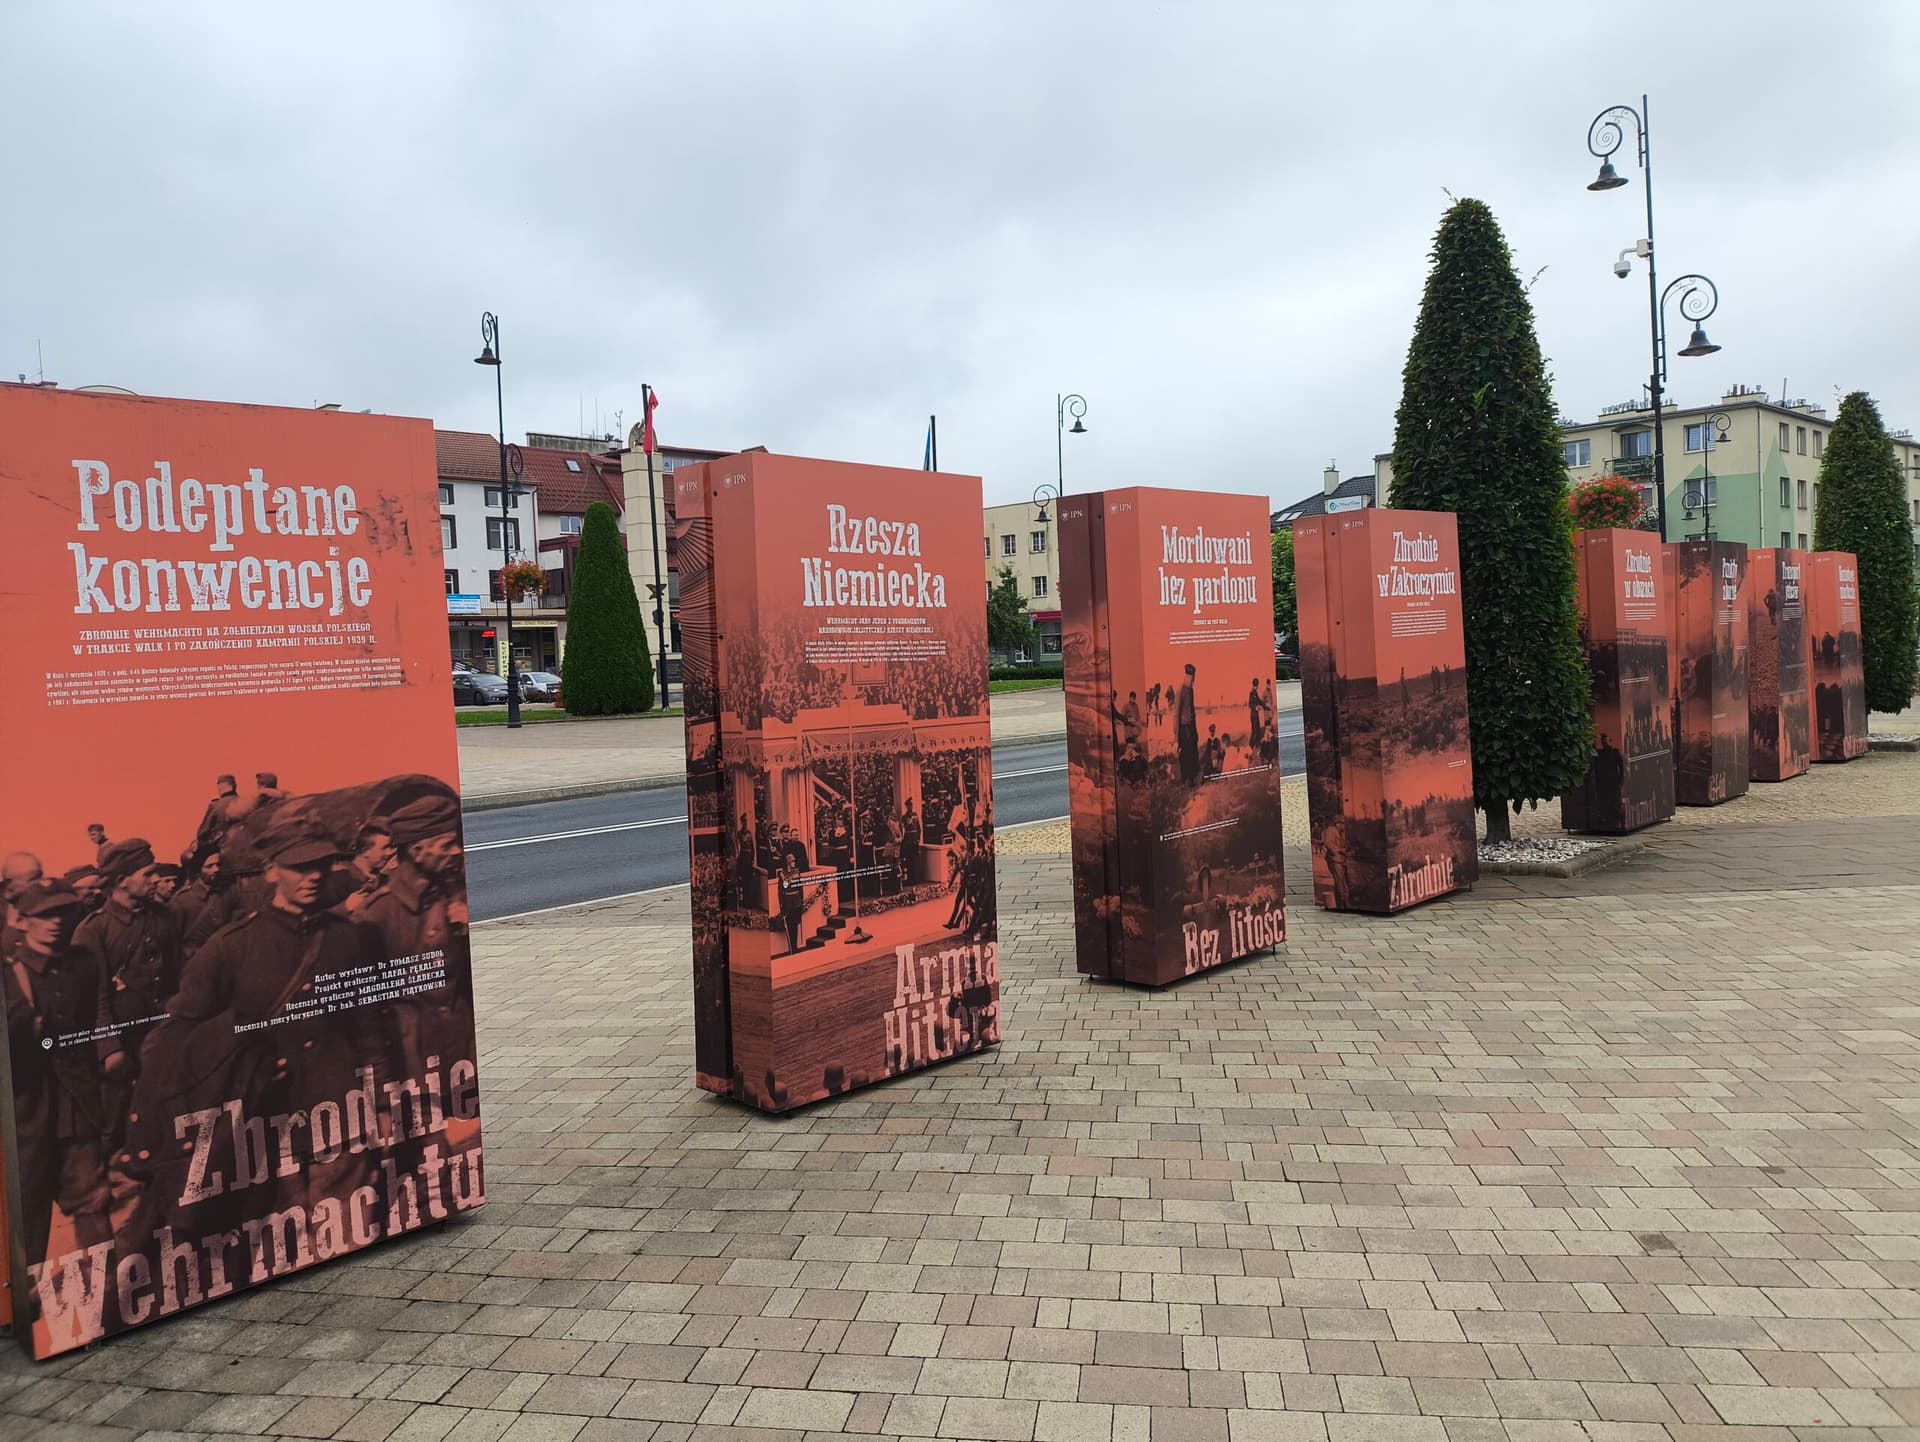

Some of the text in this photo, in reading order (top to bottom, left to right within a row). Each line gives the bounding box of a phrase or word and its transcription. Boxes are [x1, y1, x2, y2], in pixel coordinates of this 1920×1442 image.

[686, 480, 698, 492] IPN
[733, 473, 747, 484] IPN
[72, 459, 359, 551] Podeptane
[1070, 510, 1083, 519] IPN
[1119, 503, 1132, 512] IPN
[1352, 520, 1364, 528] IPN
[827, 503, 921, 557] Rzesza
[1160, 525, 1253, 565] Mordowani
[1392, 531, 1439, 563] Zbrodnie
[66, 542, 372, 617] konwencje
[800, 556, 948, 609] Niemiecka
[1158, 567, 1258, 615] bez pardonu
[1377, 566, 1456, 600] w Zakroczymiu
[72, 644, 83, 655] W
[87, 643, 131, 655] TRAKCIE
[134, 642, 163, 653] WALK
[175, 641, 186, 651] PO
[189, 637, 253, 650] ZAKOŃCZENIU
[256, 637, 300, 648] KAMPANII
[303, 636, 343, 646] POLSKIEJ
[346, 635, 366, 644] 1939
[79, 629, 130, 641] ZBRODNIE
[134, 627, 203, 639] WEHRMACHTU
[206, 626, 220, 637] NA
[288, 623, 324, 633] WOJSKA
[326, 622, 371, 633] POLSKIEGO
[1387, 853, 1455, 909] Zbrodnie
[1182, 921, 1221, 976] Bez
[314, 973, 336, 984] Autor
[338, 966, 376, 979] wystawy:
[377, 961, 387, 971] Dr
[389, 954, 420, 968] TOMASZ
[314, 983, 342, 995] Projekt
[381, 967, 408, 980] RAFAŁ
[409, 960, 445, 974] PĘKALSKI
[893, 932, 1000, 1008] Armia
[234, 1020, 268, 1034] Recenzja
[327, 1004, 338, 1013] Dr
[358, 989, 400, 1006] SEBASTIAN
[402, 979, 446, 997] PIĄTKOWSKI
[285, 999, 319, 1012] Recenzja
[358, 979, 406, 995] MAGDALENA
[883, 996, 1001, 1078] Hitlera
[174, 1054, 479, 1207] Zbrodnie
[27, 1143, 486, 1358] Wehrmachtu
